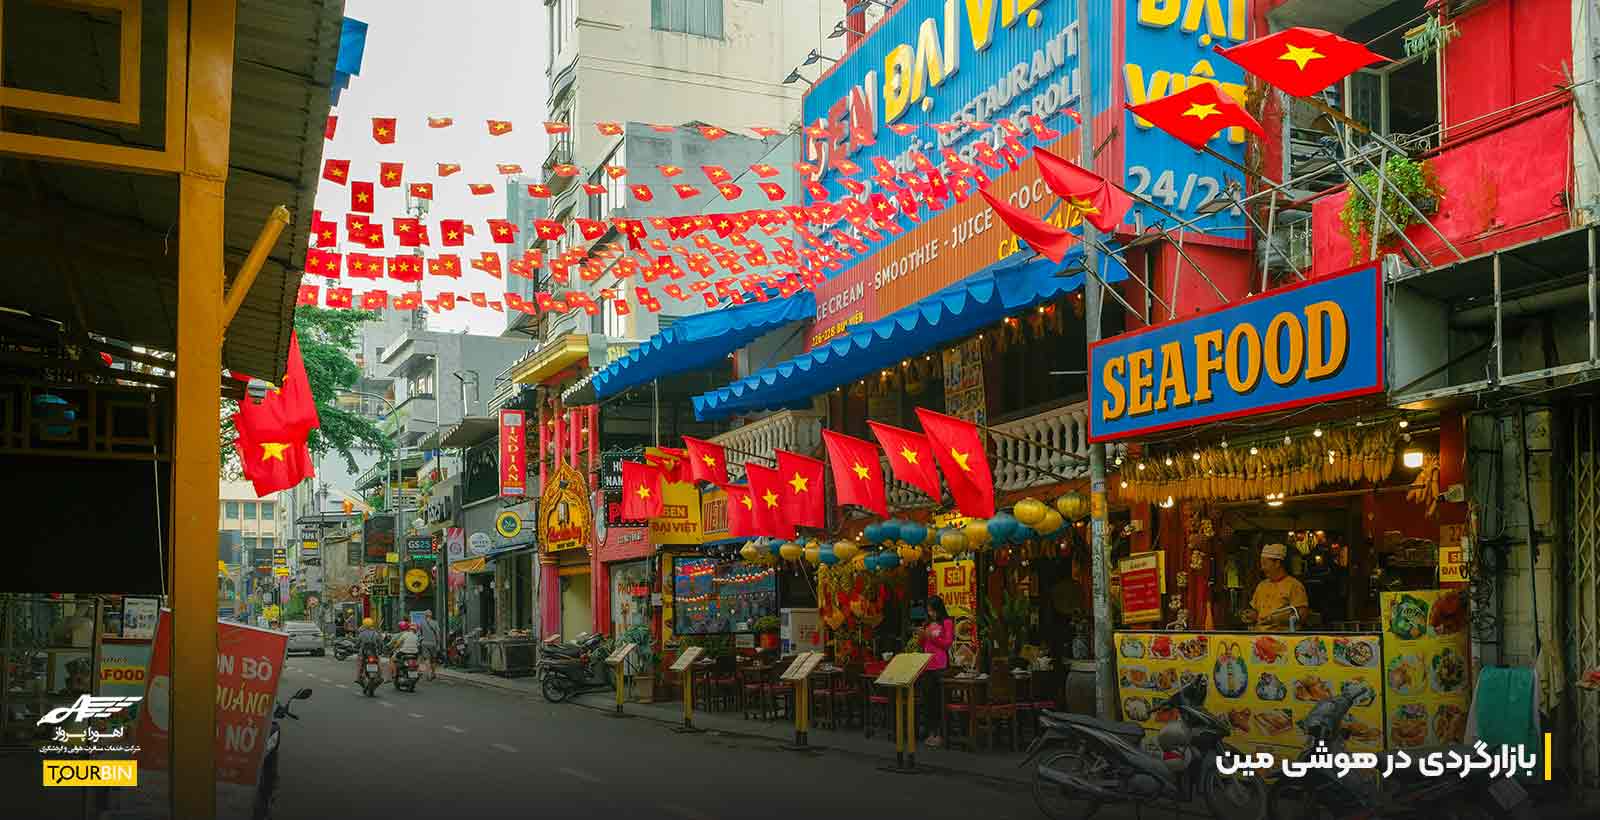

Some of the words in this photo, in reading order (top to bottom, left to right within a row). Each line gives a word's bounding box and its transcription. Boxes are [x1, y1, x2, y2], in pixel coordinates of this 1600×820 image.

[874, 239, 938, 292] SMOOTHIE
[951, 207, 993, 249] JUICE
[1102, 298, 1350, 422] SEAFOOD
[507, 426, 520, 482] INDIAN
[408, 540, 432, 550] GS25
